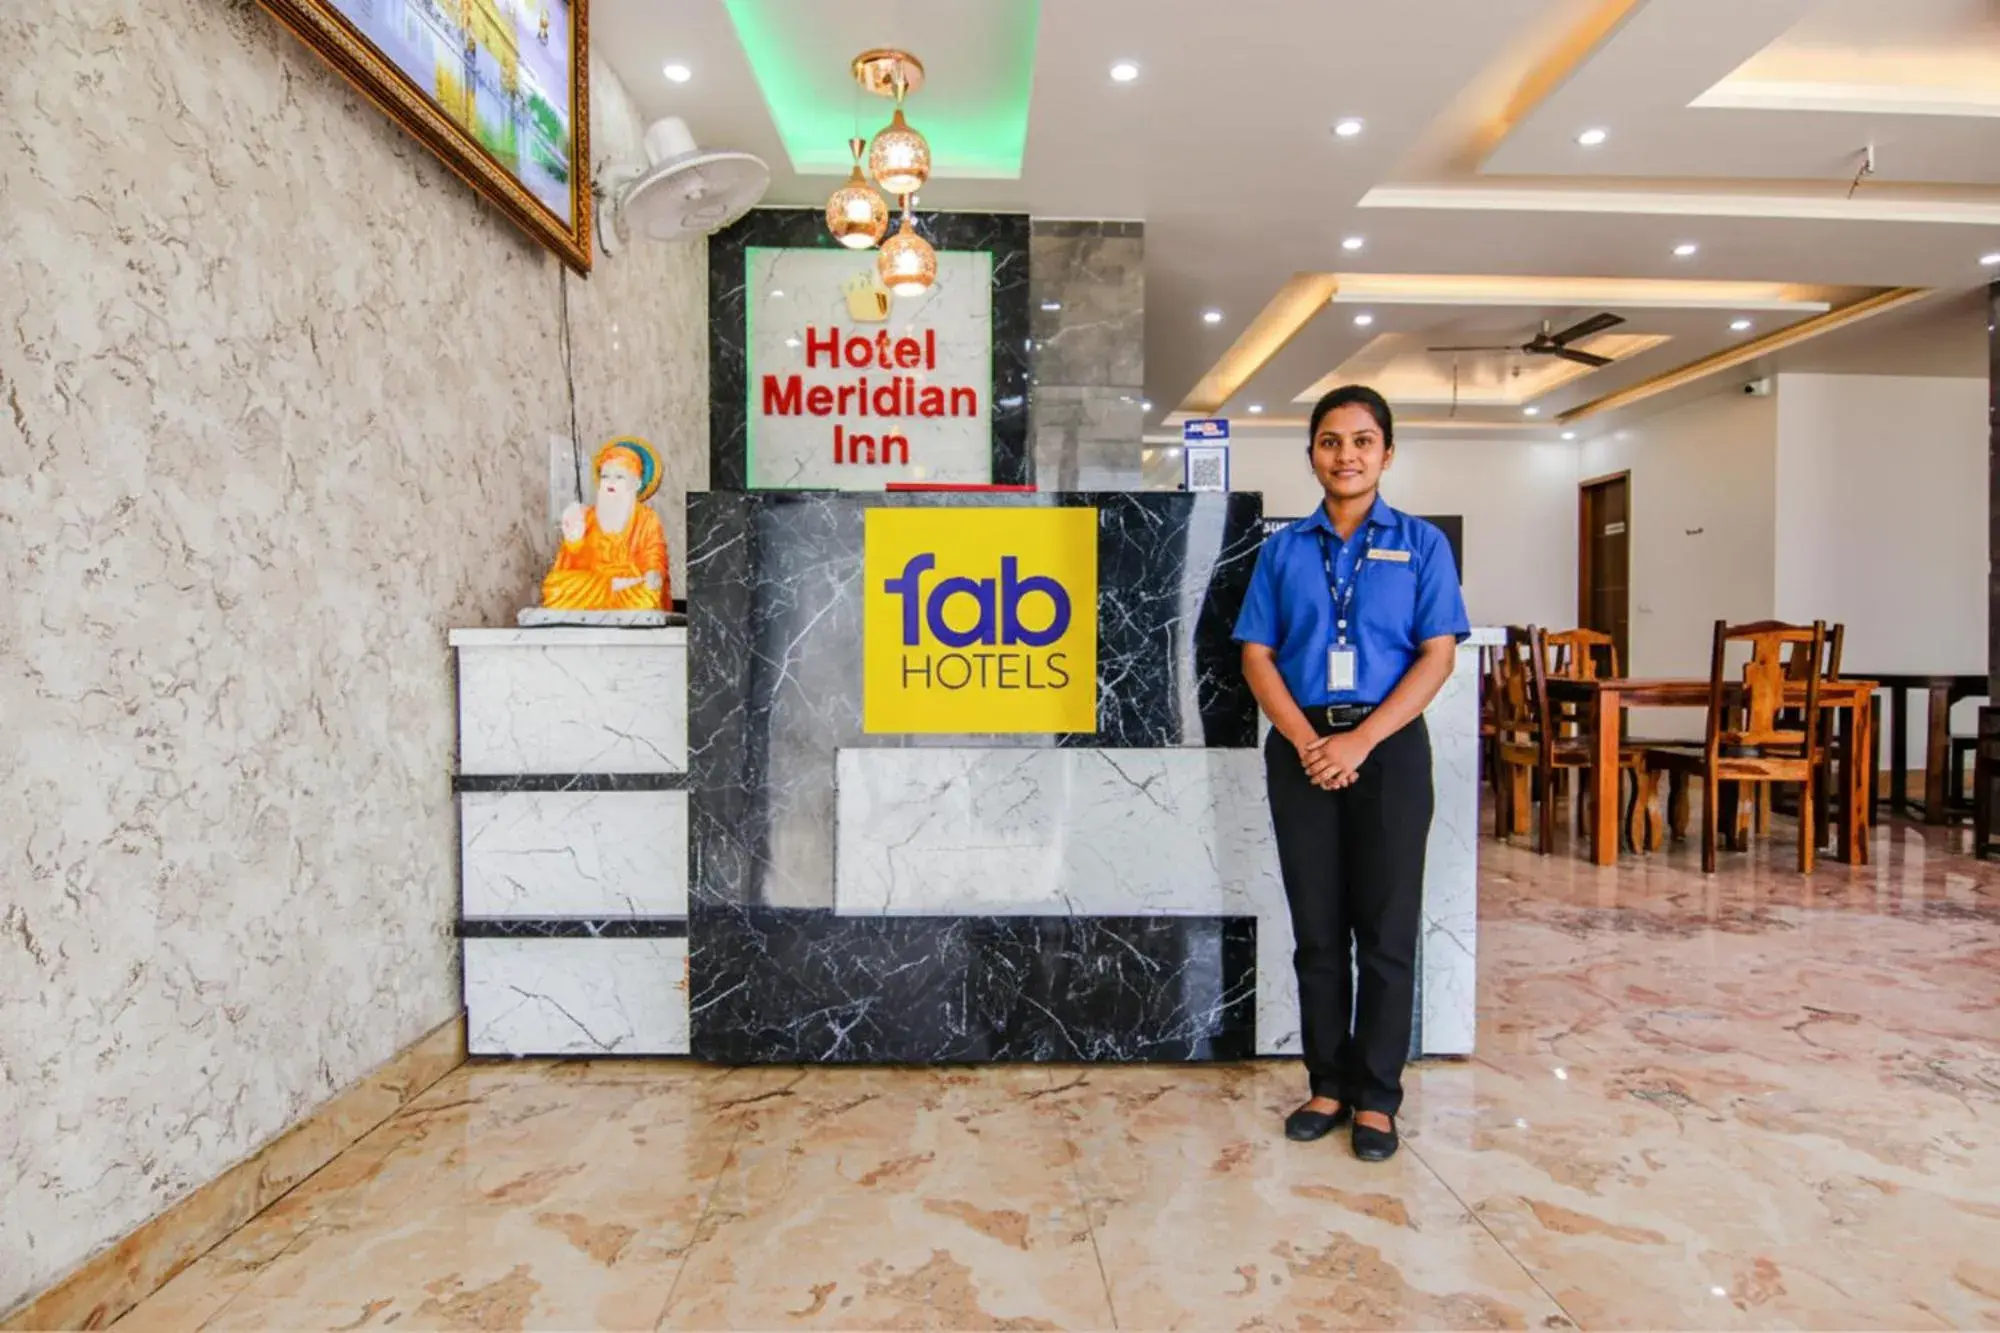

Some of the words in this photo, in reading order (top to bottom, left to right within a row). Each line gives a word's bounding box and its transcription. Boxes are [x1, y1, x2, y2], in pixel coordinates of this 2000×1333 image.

[805, 327, 936, 370] Hotel
[762, 375, 977, 417] Meridian
[833, 424, 910, 465] Inn
[884, 552, 1072, 648] fab
[902, 652, 1070, 690] HOTELS
